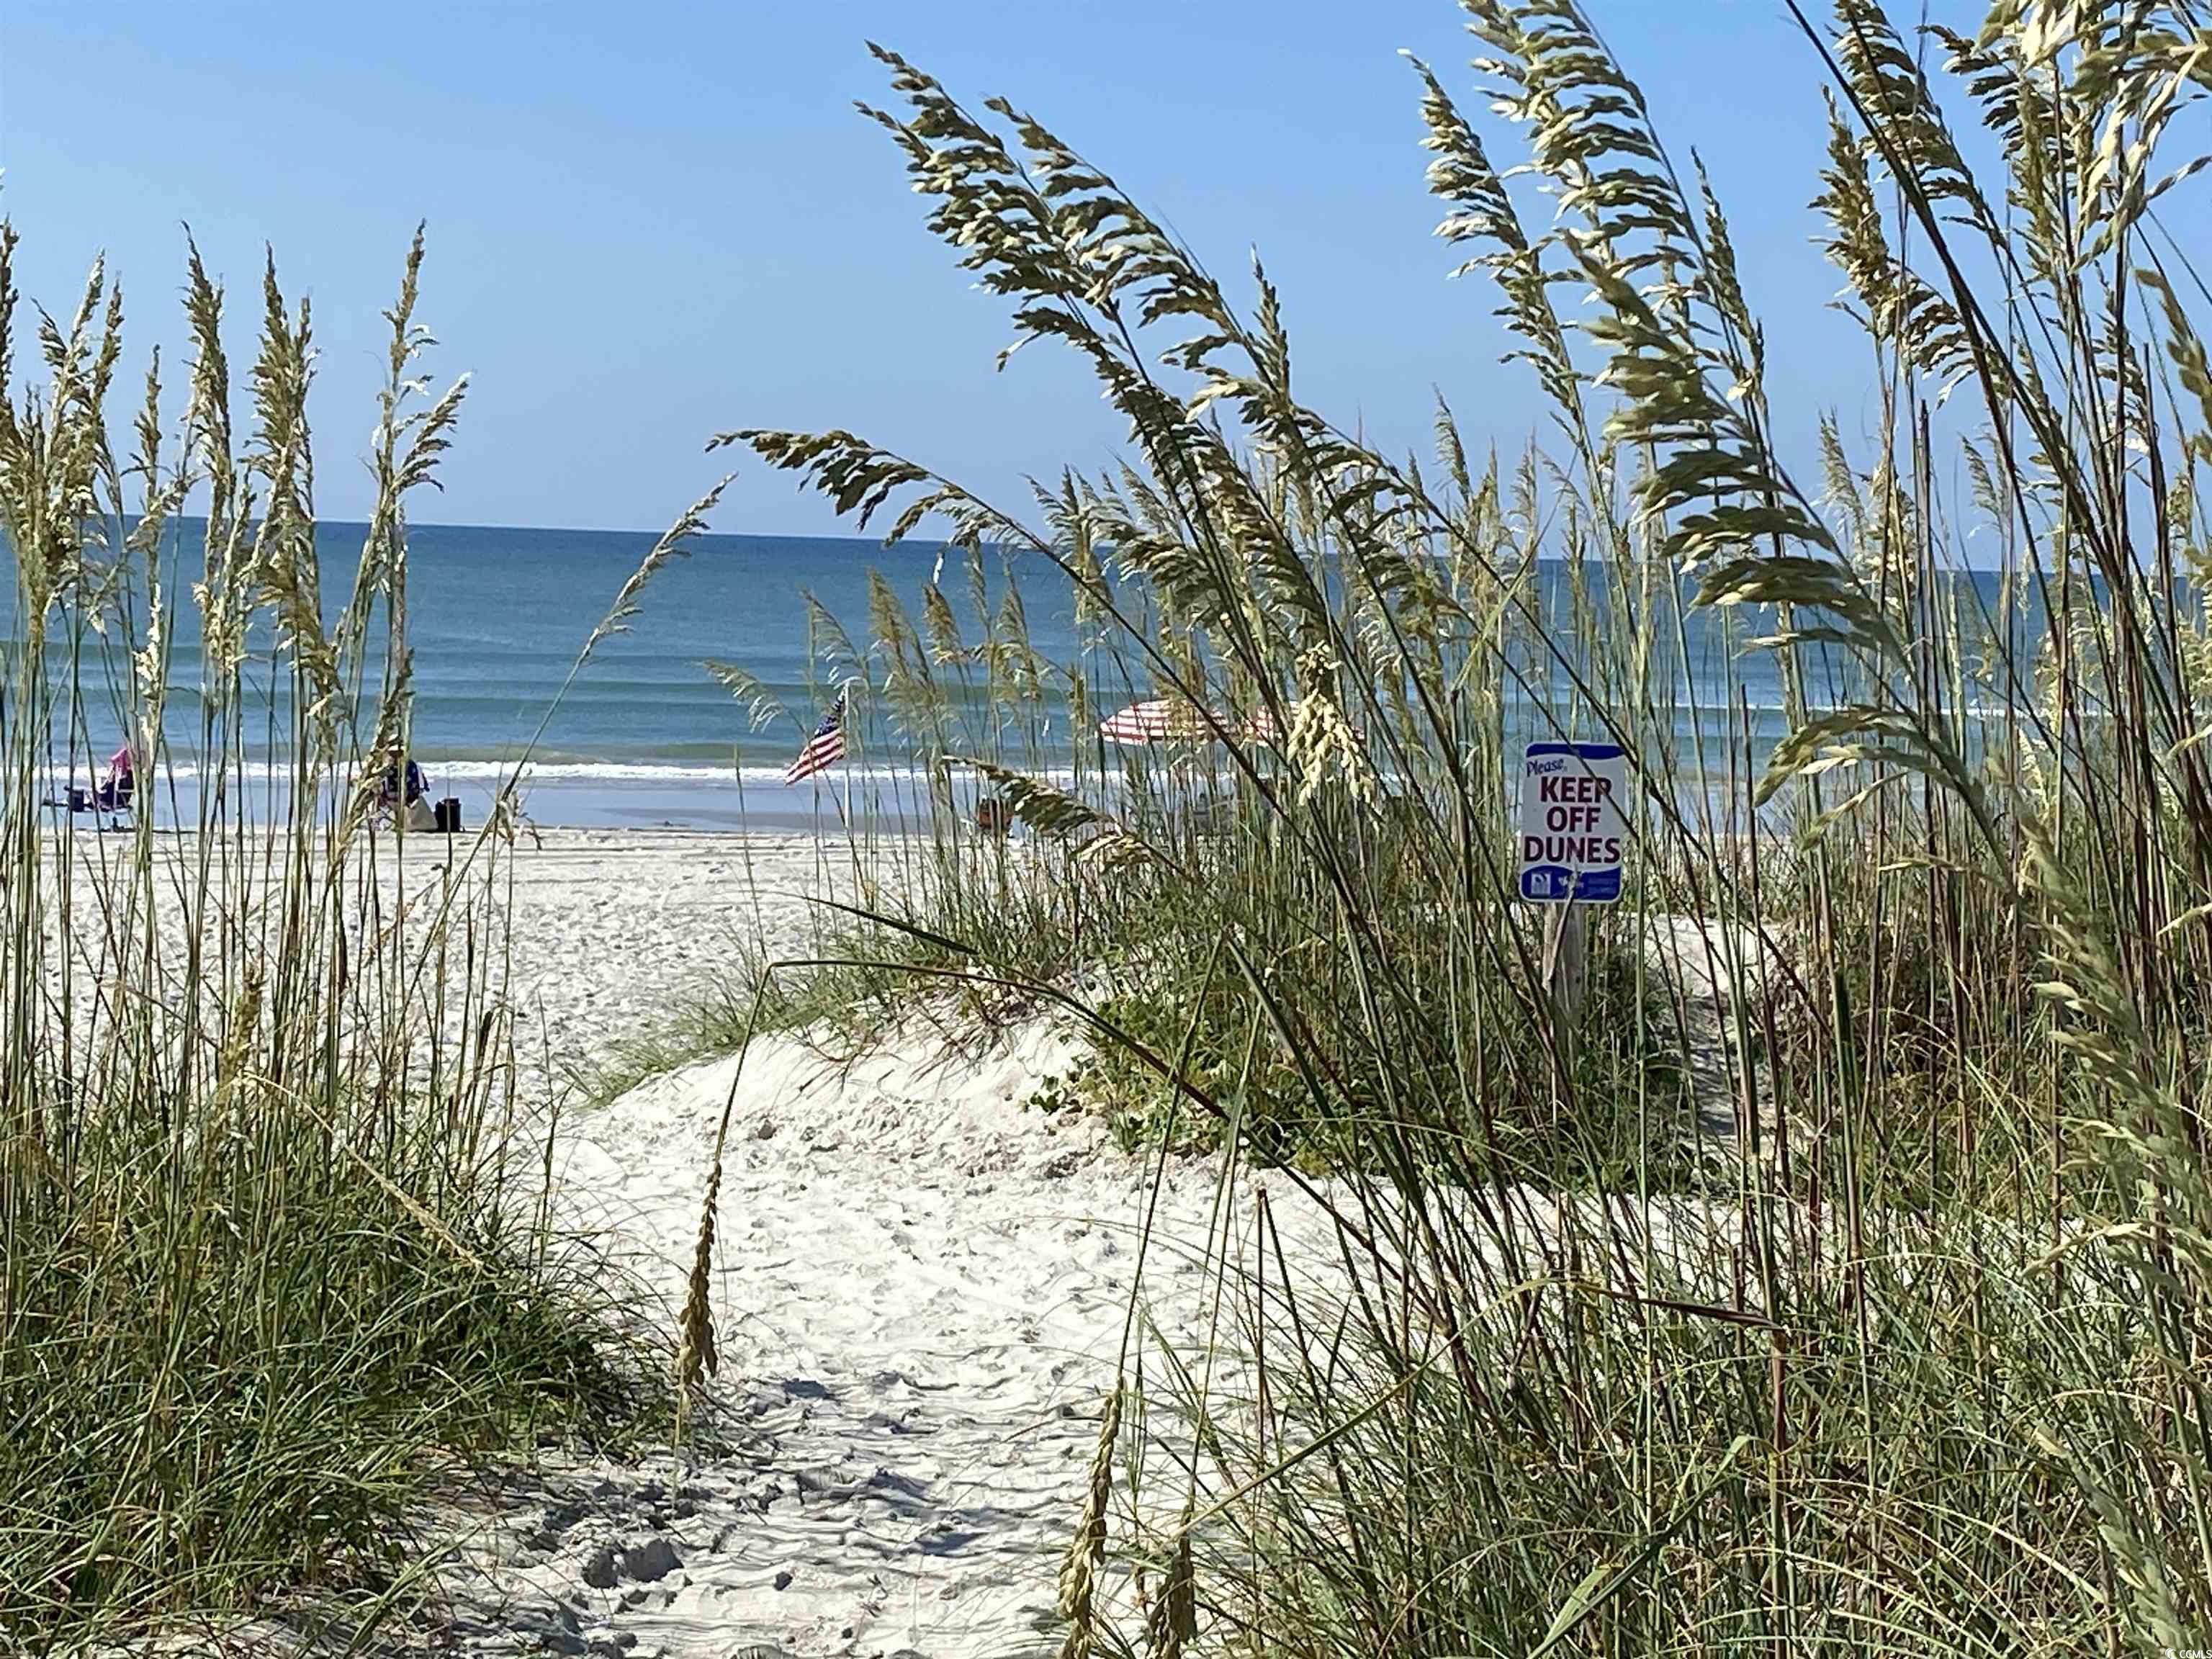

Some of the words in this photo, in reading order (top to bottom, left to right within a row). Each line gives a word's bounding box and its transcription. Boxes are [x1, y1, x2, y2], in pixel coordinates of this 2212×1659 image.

[1540, 776, 1612, 803] KEEP
[1547, 806, 1601, 832] OFF
[1524, 837, 1620, 863] DUNES
